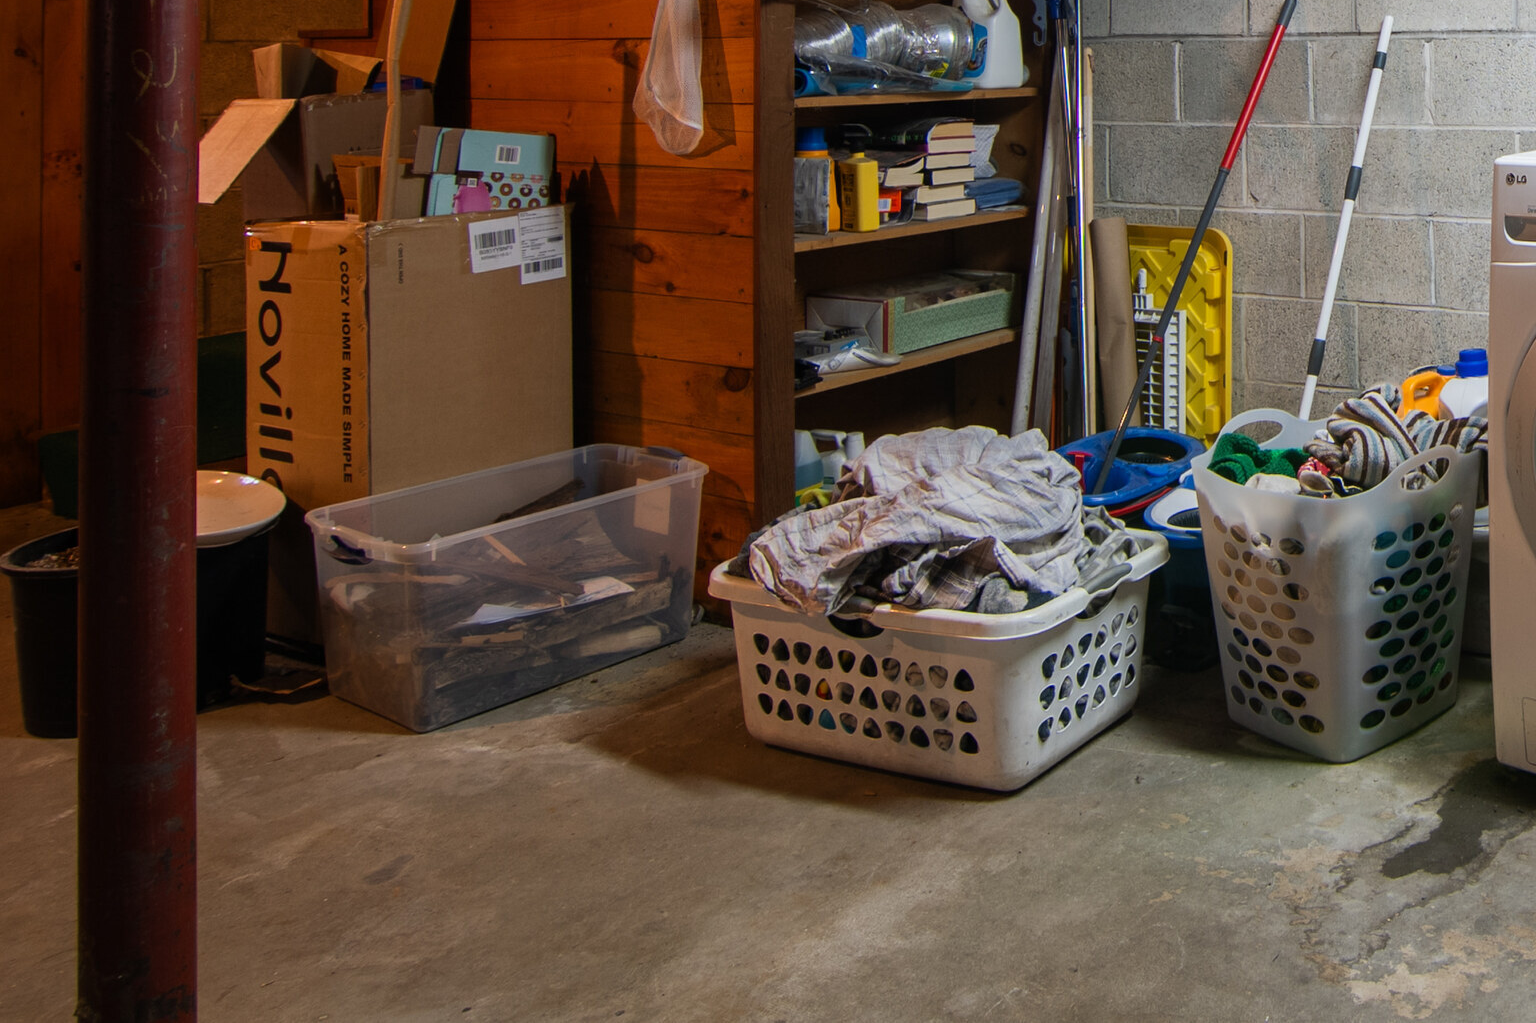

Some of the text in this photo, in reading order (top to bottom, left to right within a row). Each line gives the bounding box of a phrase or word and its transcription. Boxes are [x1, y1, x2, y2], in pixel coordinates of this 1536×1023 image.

[338, 244, 353, 483] A COZY HOME MADE SIMPLE
